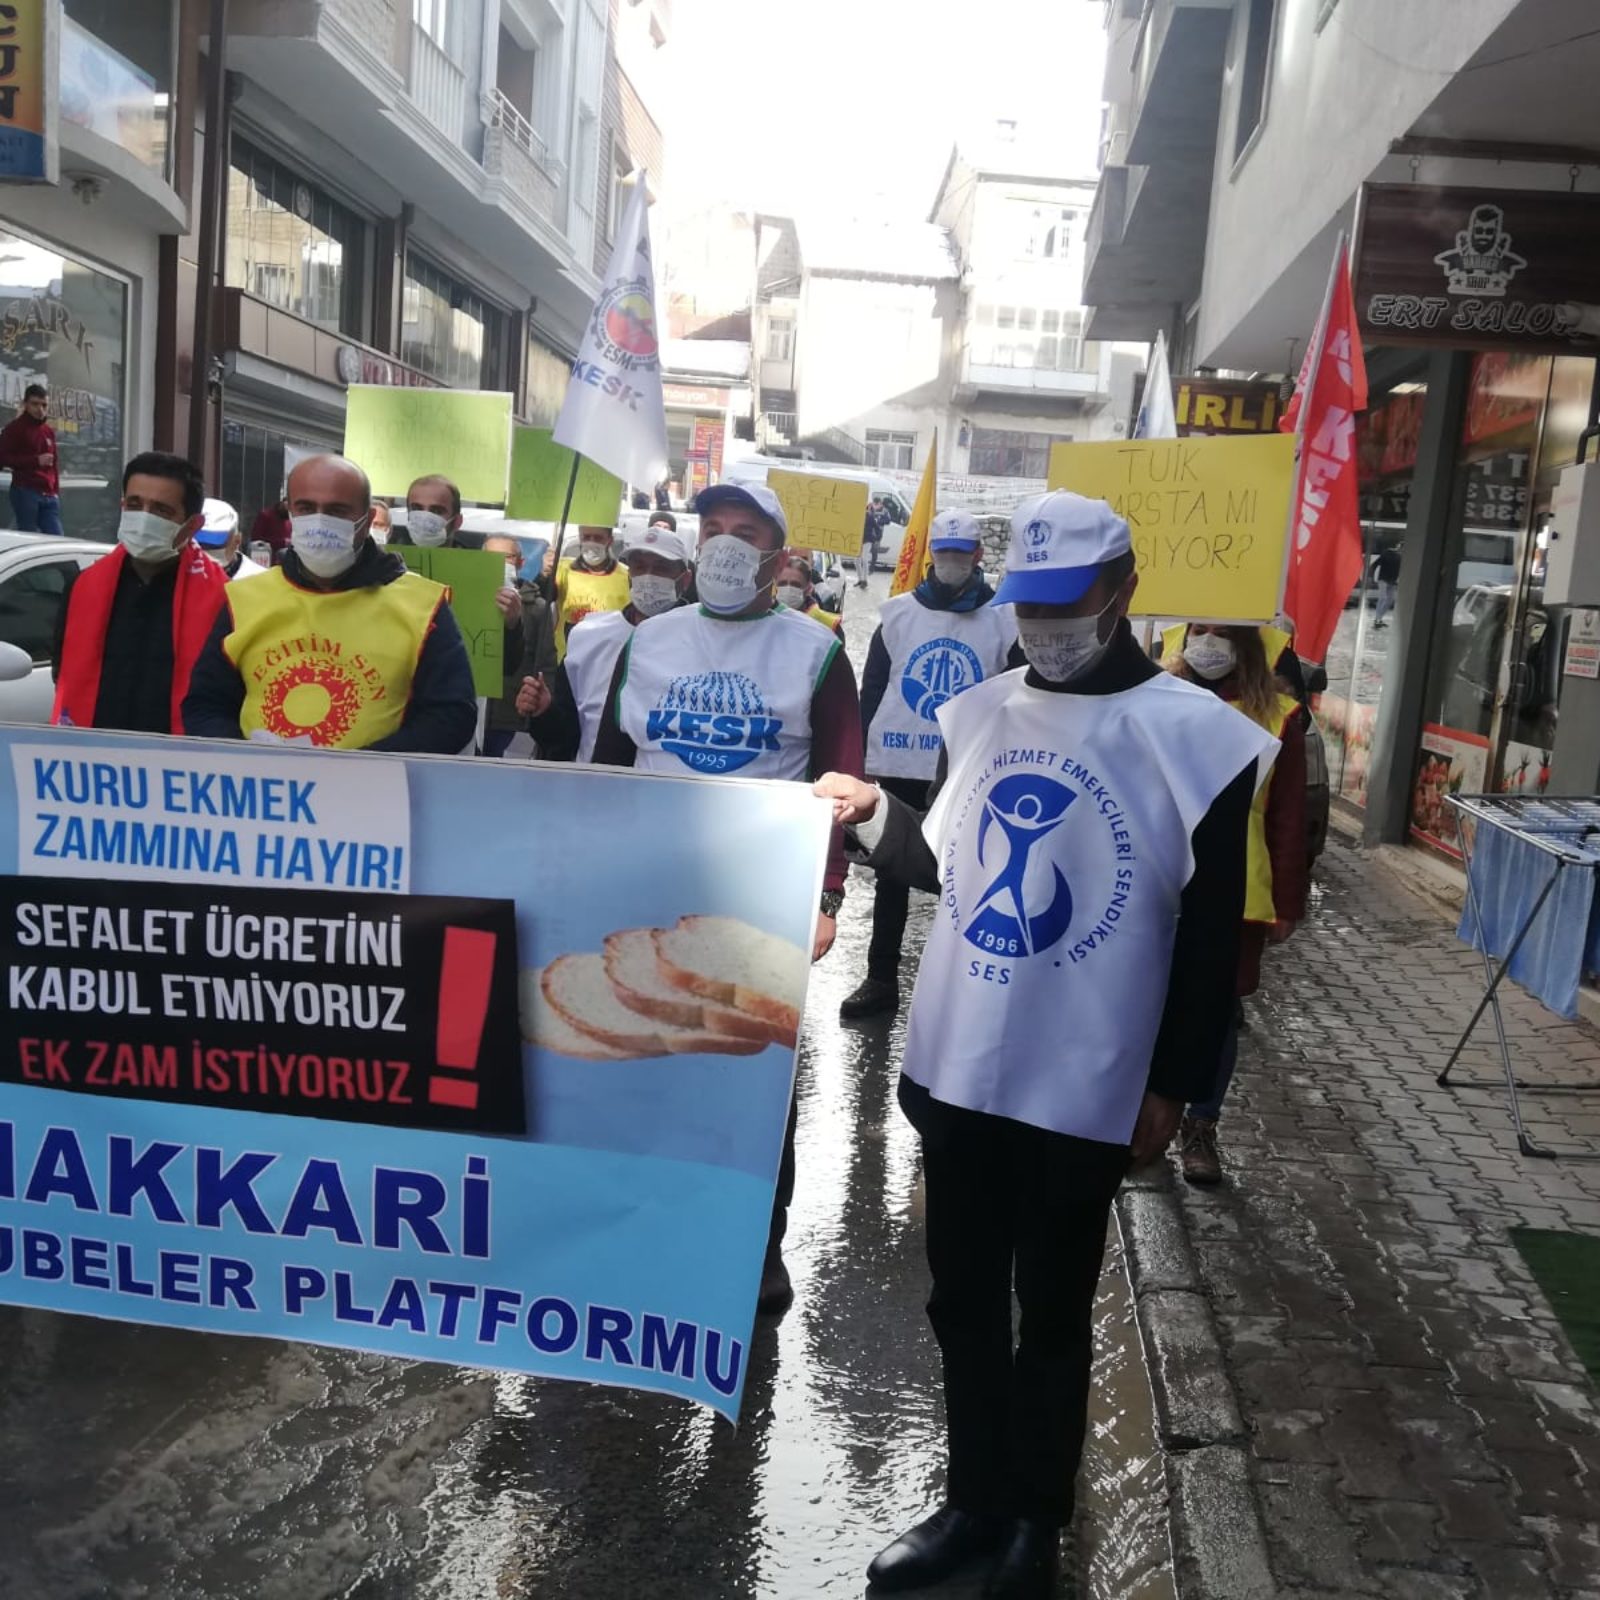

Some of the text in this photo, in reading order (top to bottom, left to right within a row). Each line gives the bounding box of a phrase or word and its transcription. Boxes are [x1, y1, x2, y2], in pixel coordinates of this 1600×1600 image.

[572, 357, 644, 412] KESK
[1176, 384, 1290, 432] İRLİ
[1102, 488, 1209, 528] ARSTA
[1026, 550, 1048, 564] SES
[253, 632, 386, 702] EĞİTİM SEN
[646, 709, 783, 752] KESK
[688, 751, 728, 769] 1995
[883, 731, 909, 749] KESK
[993, 748, 1058, 773] HİZMET
[33, 757, 317, 824] KURU EKMEK
[1060, 758, 1137, 862] EMEKÇİLERİ
[33, 812, 404, 891] ZAMMINA HAYIR!
[16, 902, 402, 967] SEFALET ÜCRETİNİ
[976, 928, 1019, 953] 1996
[1067, 868, 1133, 964] SENDİKASI
[8, 965, 407, 1033] KABUL ETMİYORUZ
[968, 960, 1011, 985] SES
[18, 1036, 413, 1105] EK ZAM İSTİYORUZ
[0, 1120, 491, 1260] AKKARİ
[283, 1263, 743, 1397] PLATFORMU
